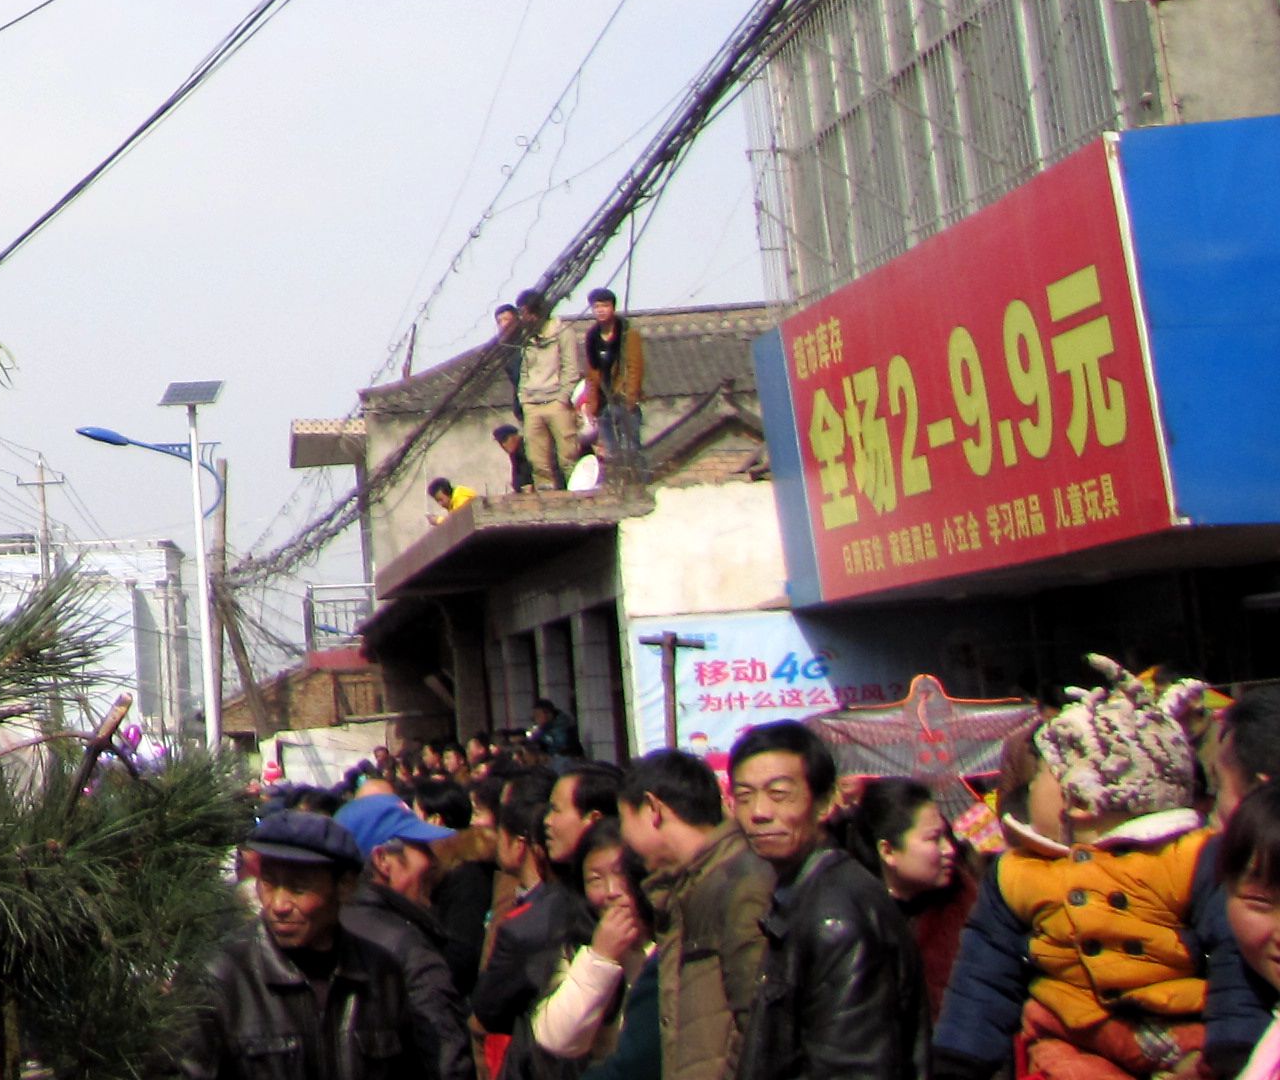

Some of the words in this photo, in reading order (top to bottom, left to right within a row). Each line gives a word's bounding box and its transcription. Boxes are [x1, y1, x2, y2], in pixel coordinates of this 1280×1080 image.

[809, 264, 1127, 530] 全场2-9.9元
[943, 511, 982, 555] 小五金
[986, 494, 1045, 545] 学习用品
[1053, 473, 1119, 528] 儿童玩具
